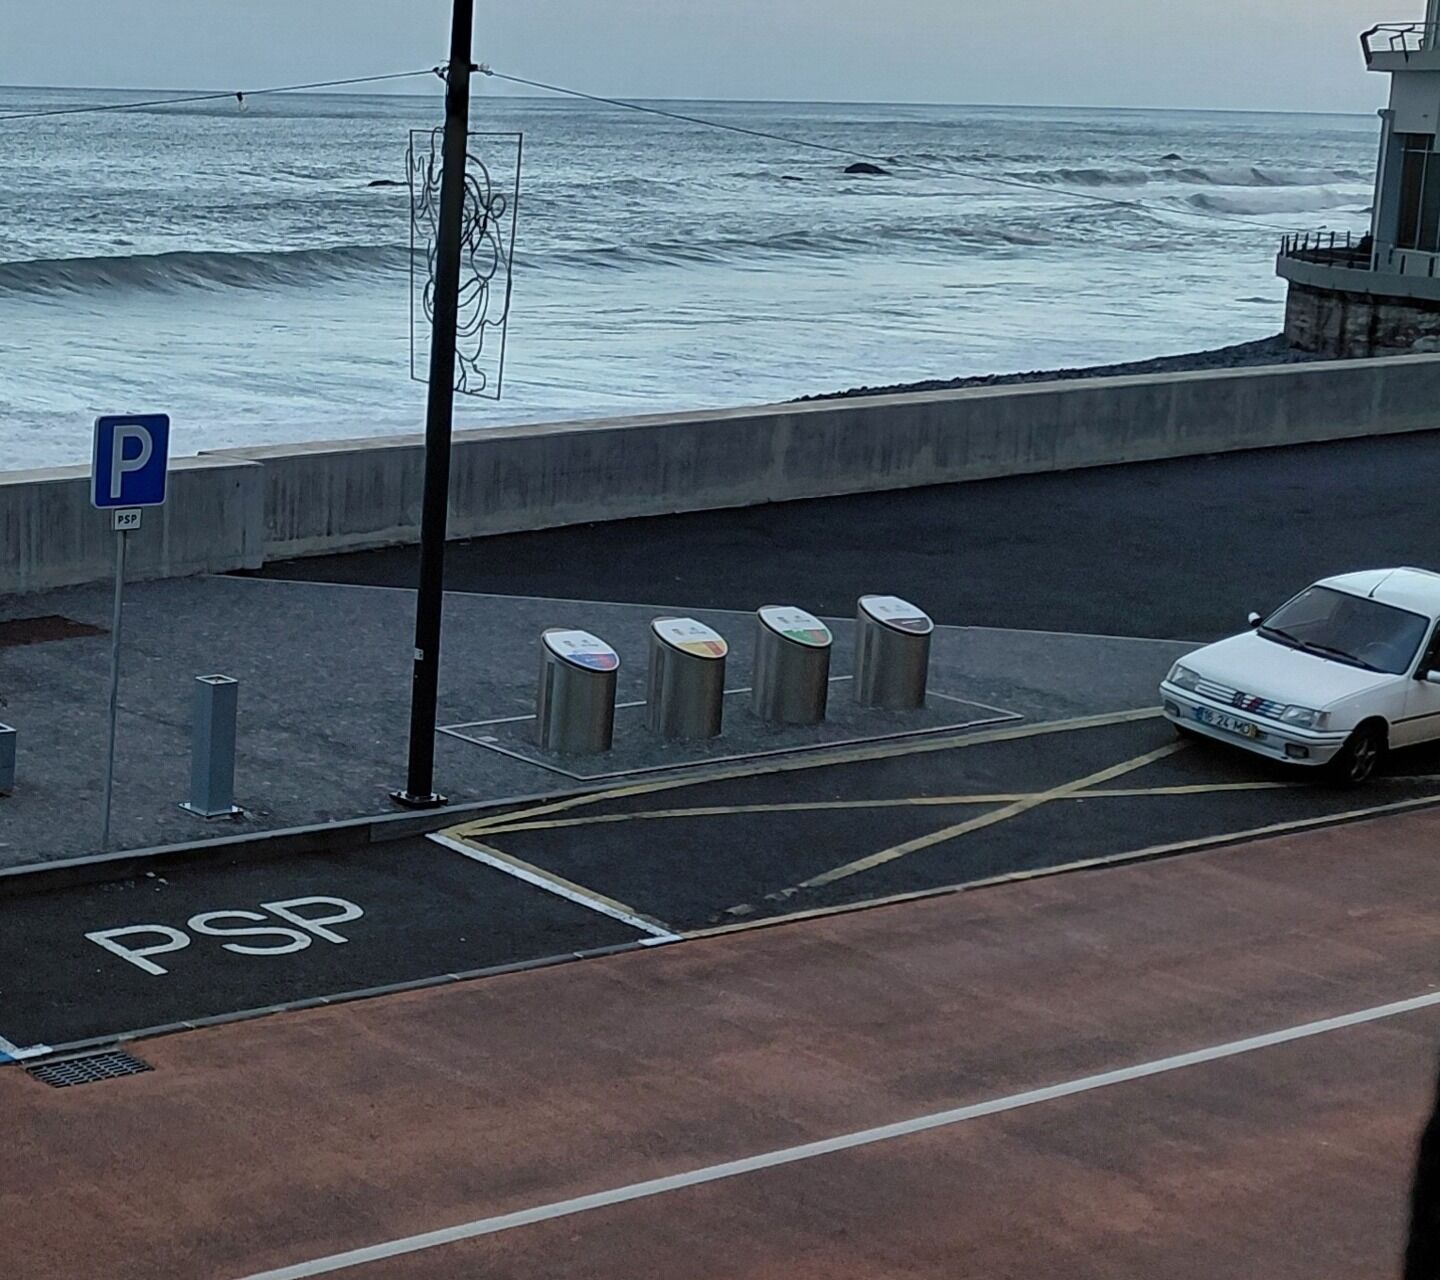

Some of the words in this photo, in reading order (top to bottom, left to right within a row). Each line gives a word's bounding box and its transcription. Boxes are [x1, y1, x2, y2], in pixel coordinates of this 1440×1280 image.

[109, 425, 153, 499] P
[118, 514, 137, 525] PSP
[84, 896, 364, 976] PSP
